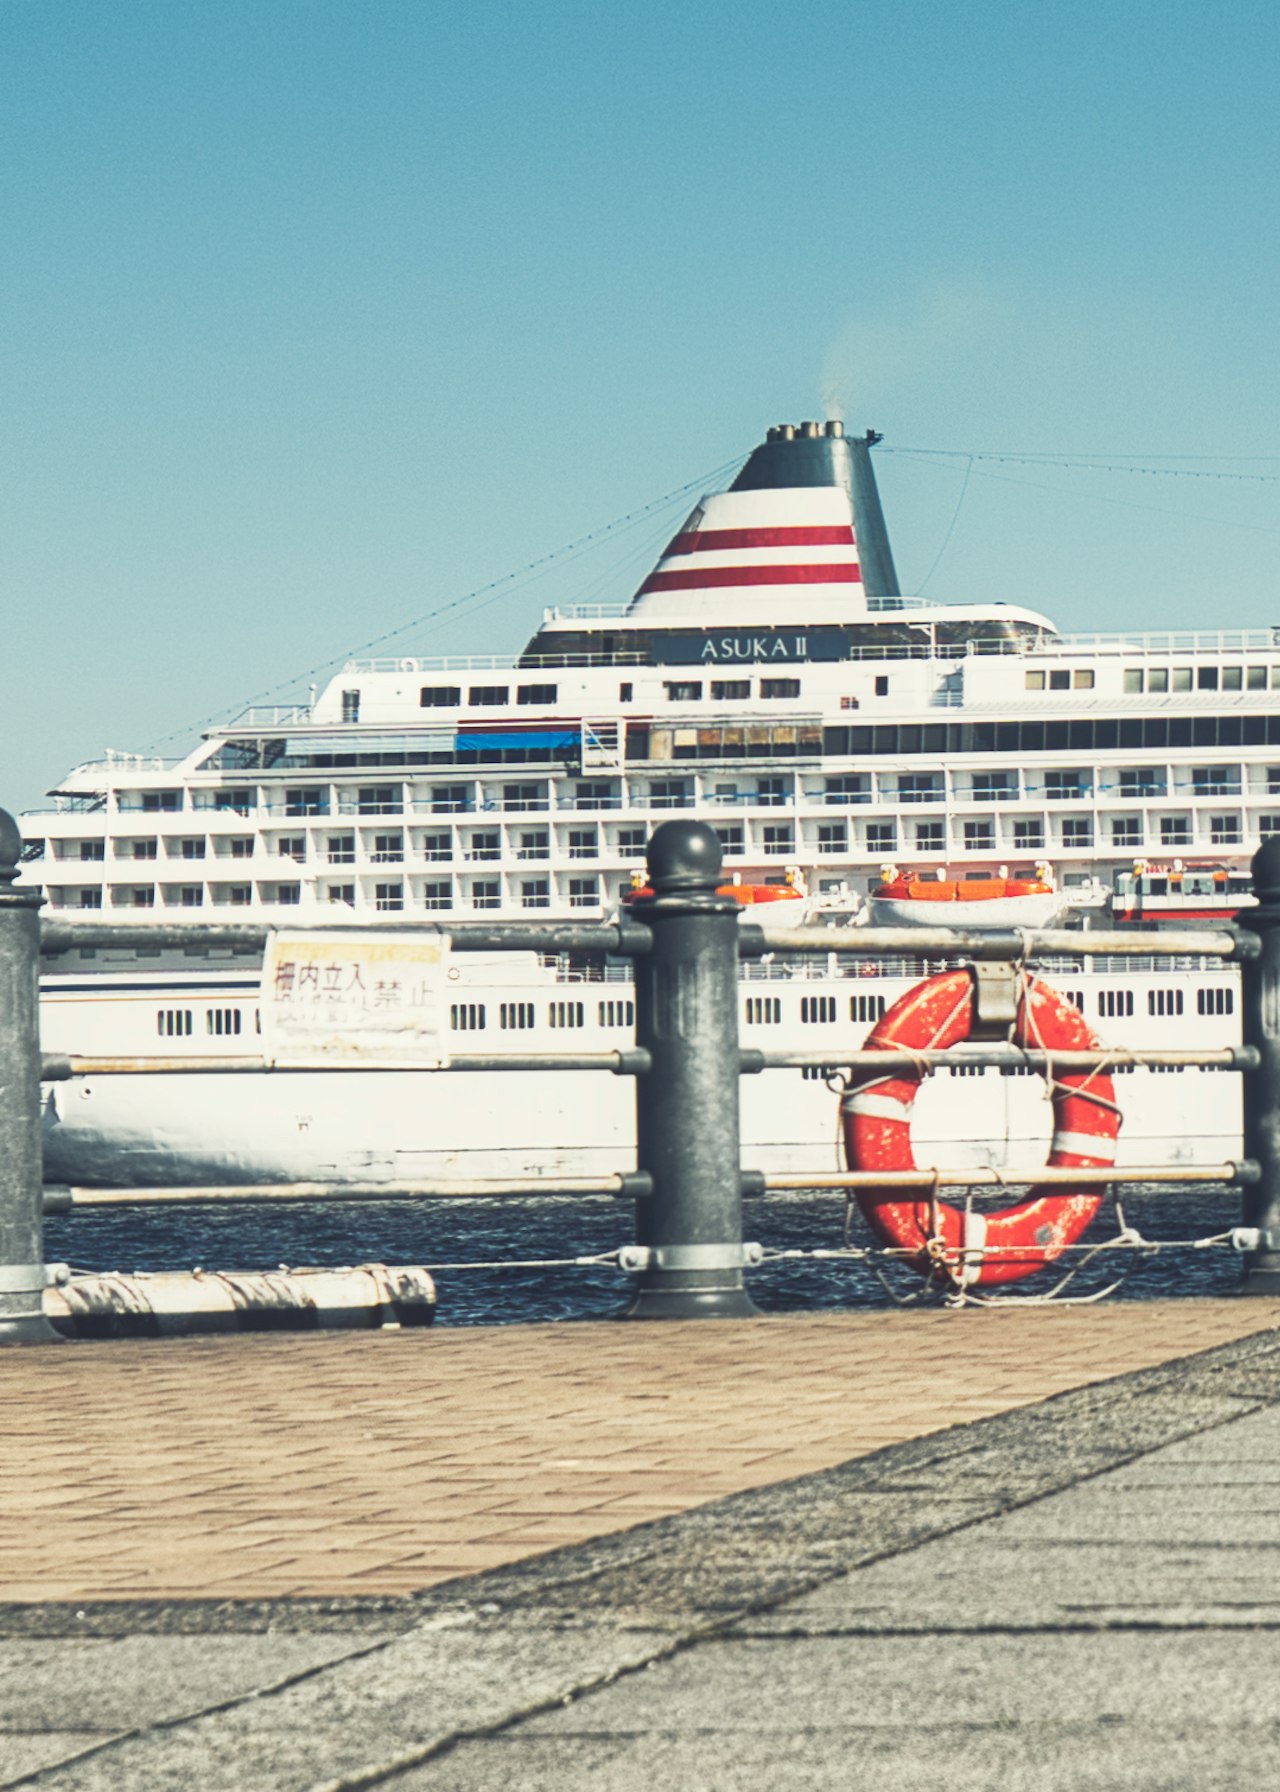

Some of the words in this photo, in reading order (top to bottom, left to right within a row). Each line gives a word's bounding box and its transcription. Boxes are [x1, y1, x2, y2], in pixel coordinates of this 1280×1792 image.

[701, 637, 788, 658] ASUKA
[795, 636, 807, 656] II
[374, 980, 437, 1008] 禁止
